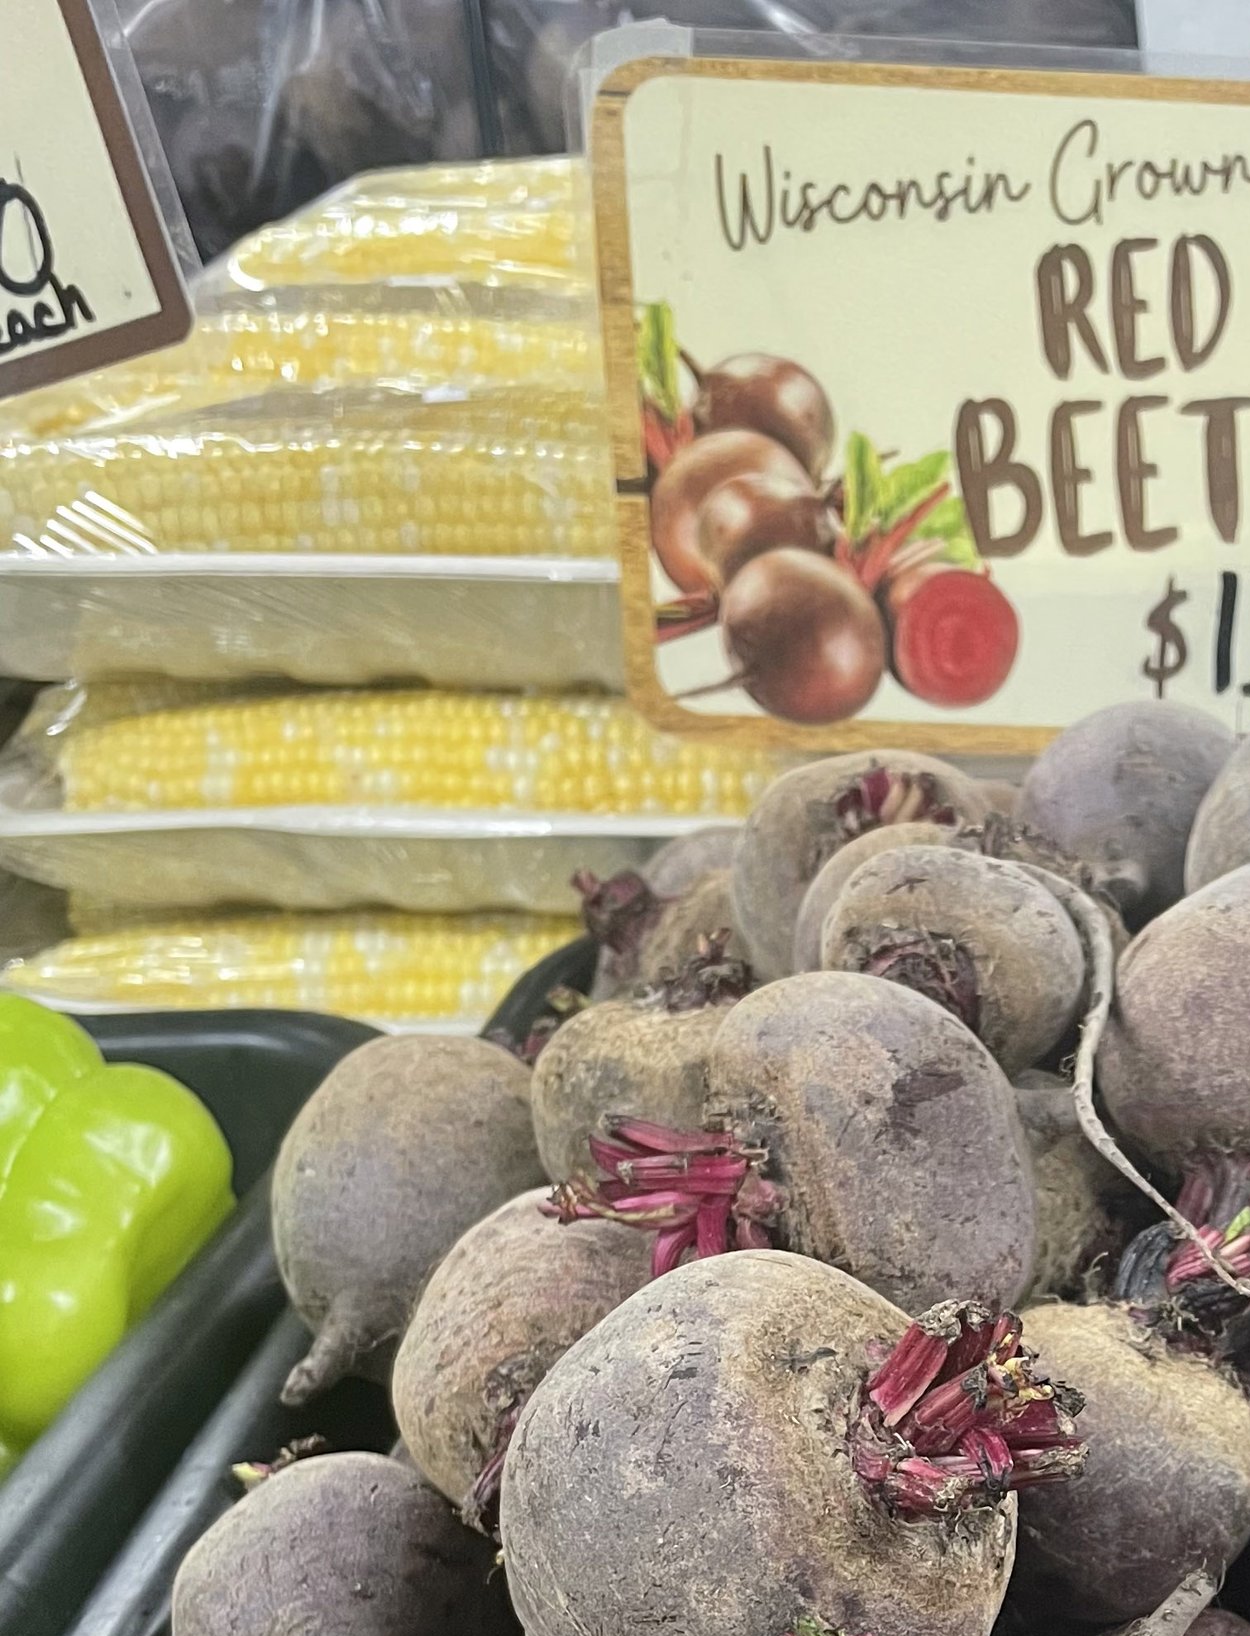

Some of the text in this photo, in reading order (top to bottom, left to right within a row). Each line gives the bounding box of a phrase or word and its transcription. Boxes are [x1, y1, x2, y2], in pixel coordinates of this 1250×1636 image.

[714, 145, 1031, 252] Wisconsin
[0, 272, 96, 352] ach
[1036, 233, 1232, 381] RED
